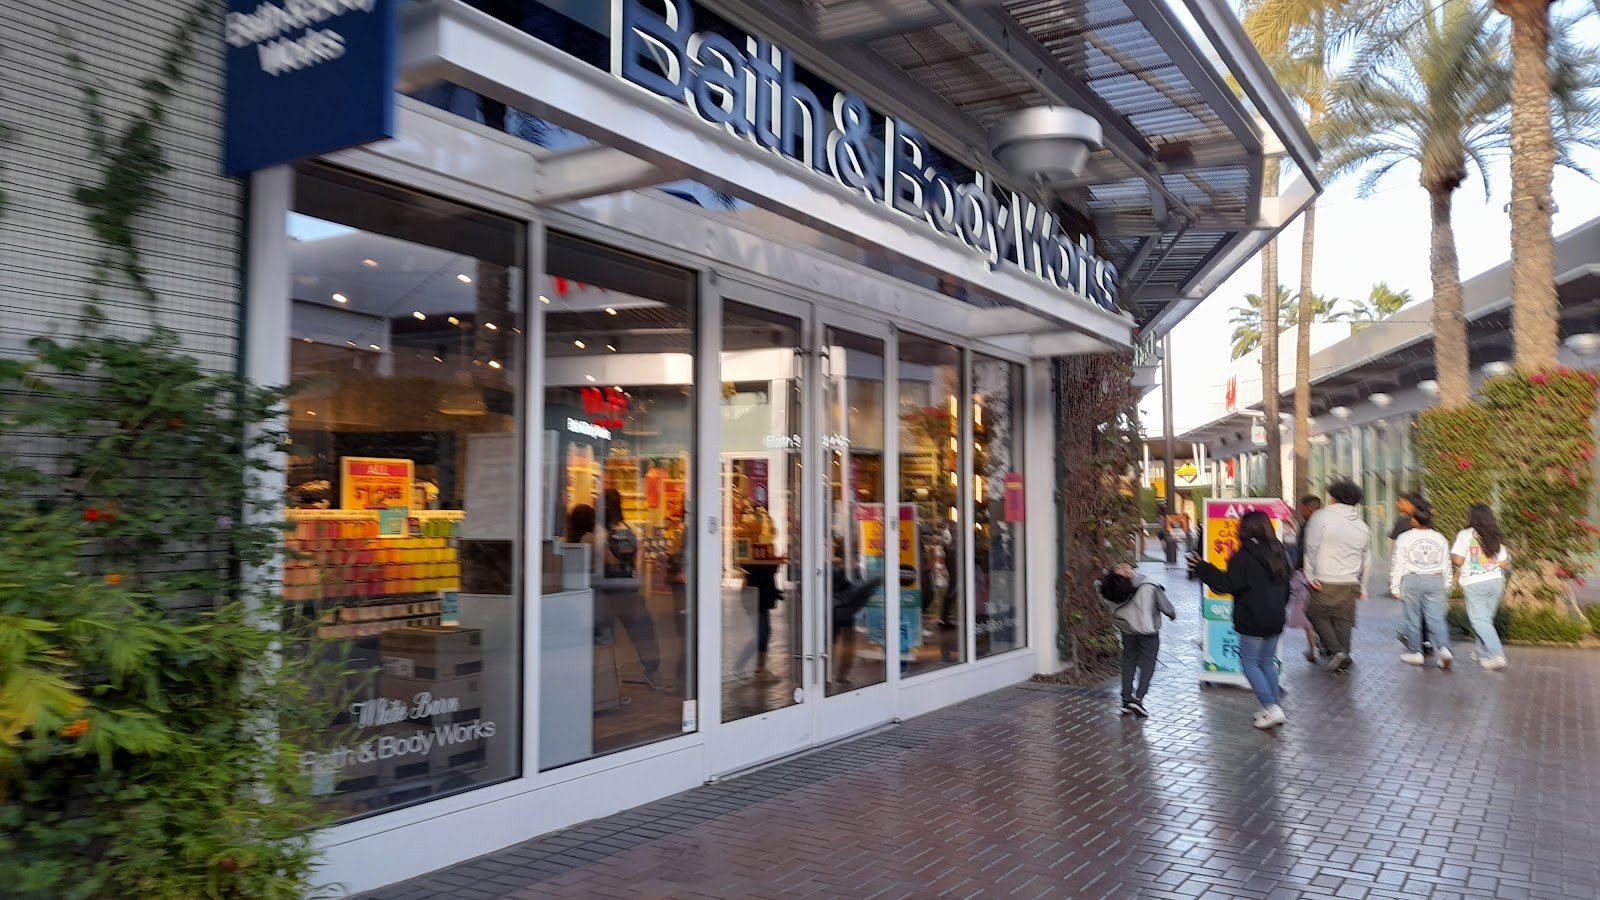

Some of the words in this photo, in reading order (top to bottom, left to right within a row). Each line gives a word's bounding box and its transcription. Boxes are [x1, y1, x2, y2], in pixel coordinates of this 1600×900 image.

[609, 0, 828, 174] Bath
[826, 89, 886, 201] &
[884, 115, 1011, 273] Body
[1010, 190, 1120, 315] Works
[349, 698, 410, 729] White
[408, 691, 461, 719] Barn
[357, 741, 377, 763] &
[378, 730, 435, 759] Body
[434, 719, 496, 747] Works
